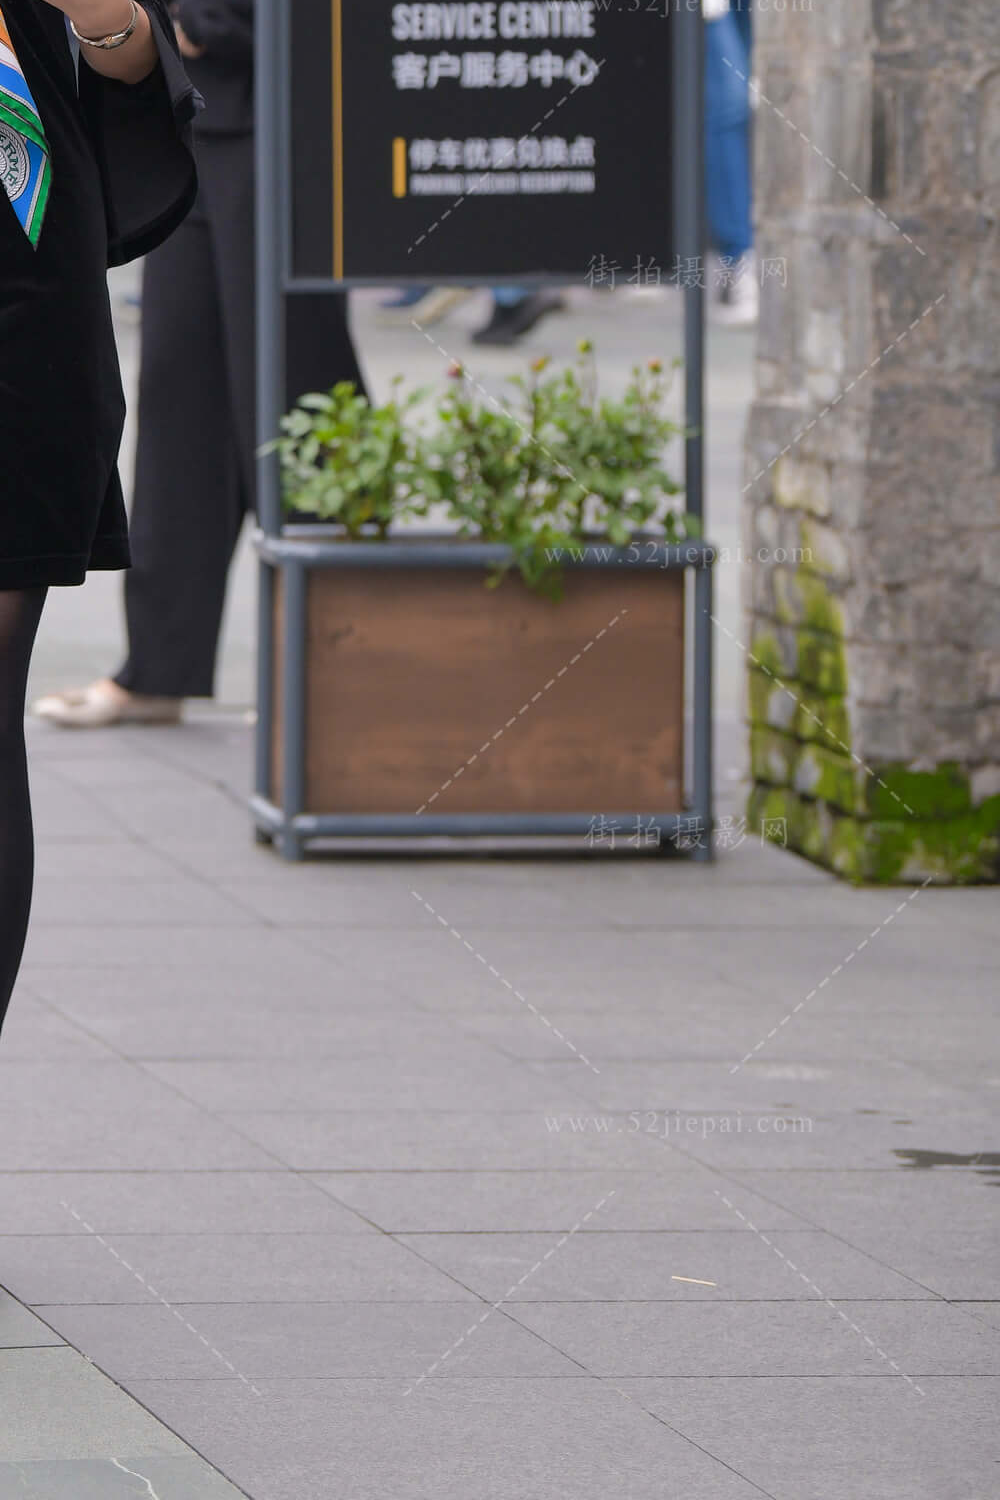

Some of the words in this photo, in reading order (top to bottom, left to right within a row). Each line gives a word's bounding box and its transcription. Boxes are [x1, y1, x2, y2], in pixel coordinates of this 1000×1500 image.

[392, 2, 497, 40] SERVICE
[499, 2, 596, 39] CENTRE
[392, 50, 599, 89] 客户服务中心
